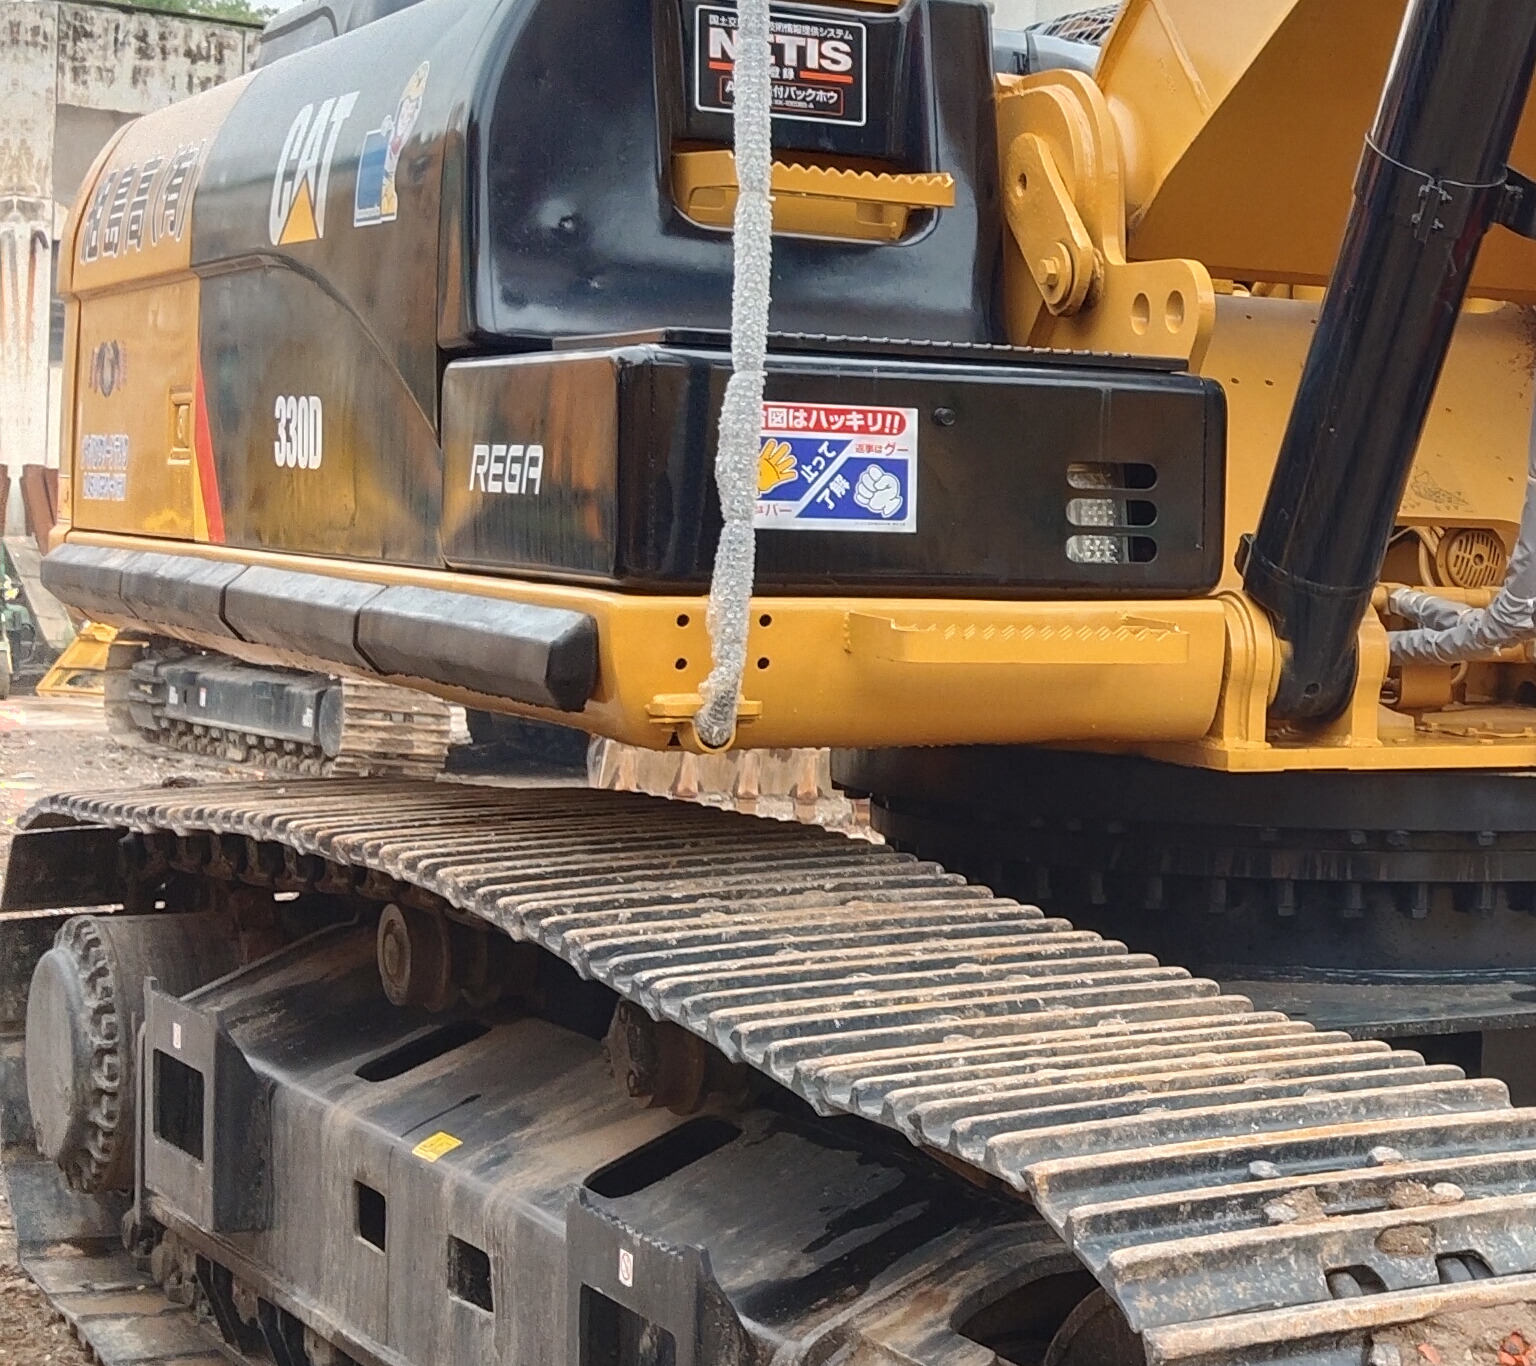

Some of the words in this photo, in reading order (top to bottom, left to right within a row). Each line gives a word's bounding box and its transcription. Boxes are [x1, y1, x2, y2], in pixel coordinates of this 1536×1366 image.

[269, 91, 360, 246] CAT
[274, 395, 323, 470] 330D
[468, 443, 544, 495] REGA
